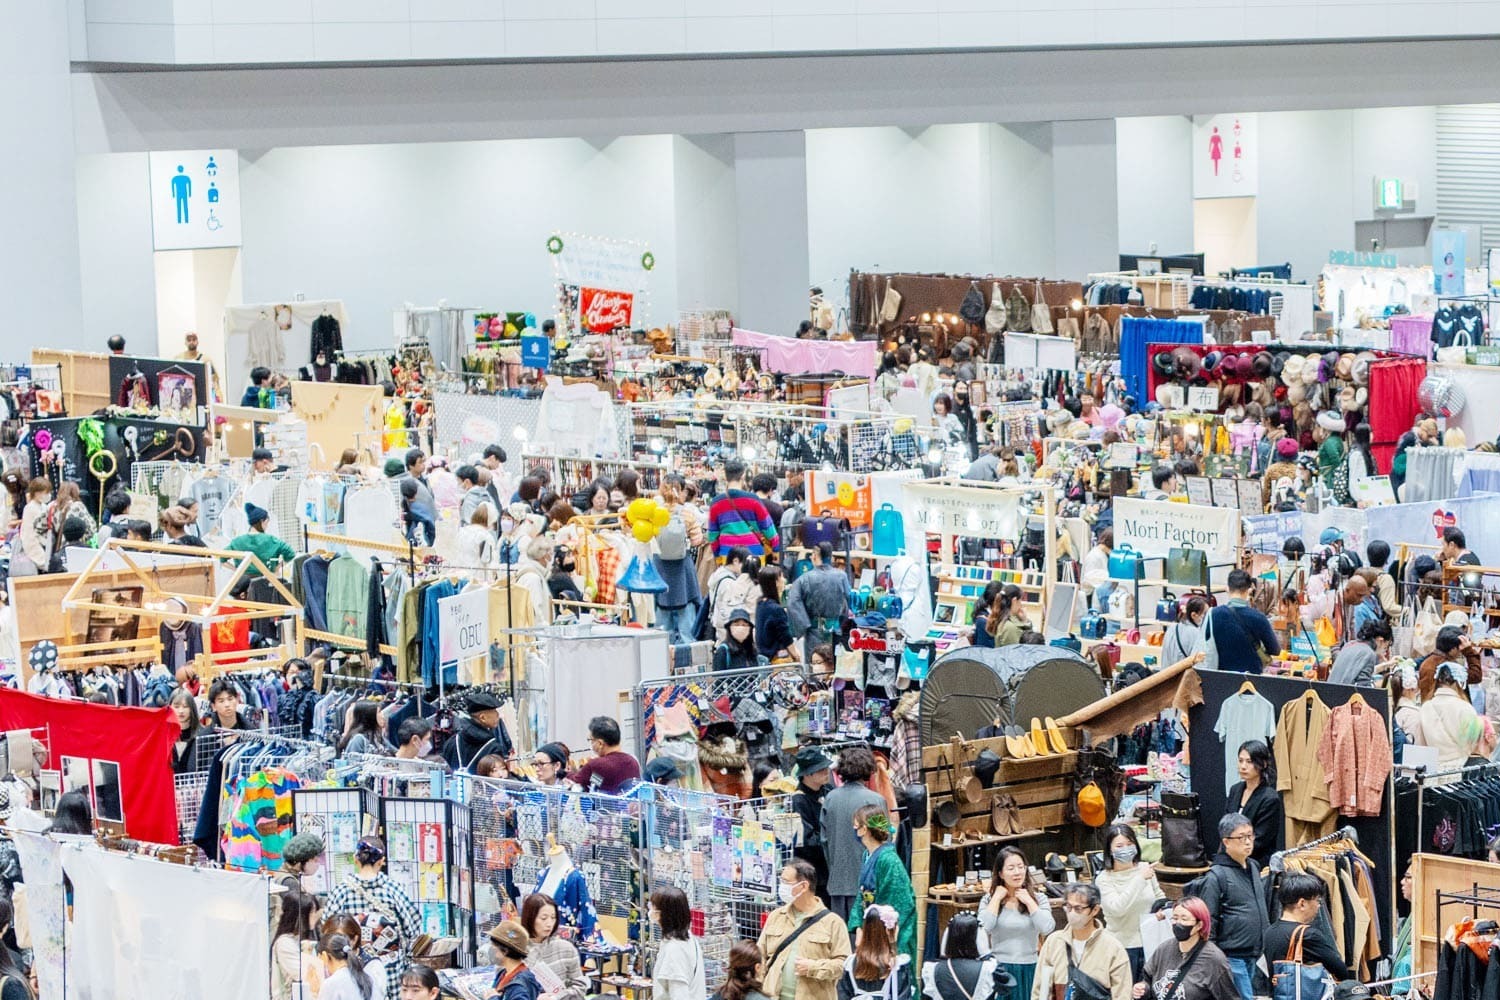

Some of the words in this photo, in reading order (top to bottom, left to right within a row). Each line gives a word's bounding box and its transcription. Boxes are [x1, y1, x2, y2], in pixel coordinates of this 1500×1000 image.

[918, 510, 946, 526] Mri
[1124, 518, 1159, 538] Mori
[1163, 521, 1219, 546] Factory
[459, 621, 482, 650] OBU
